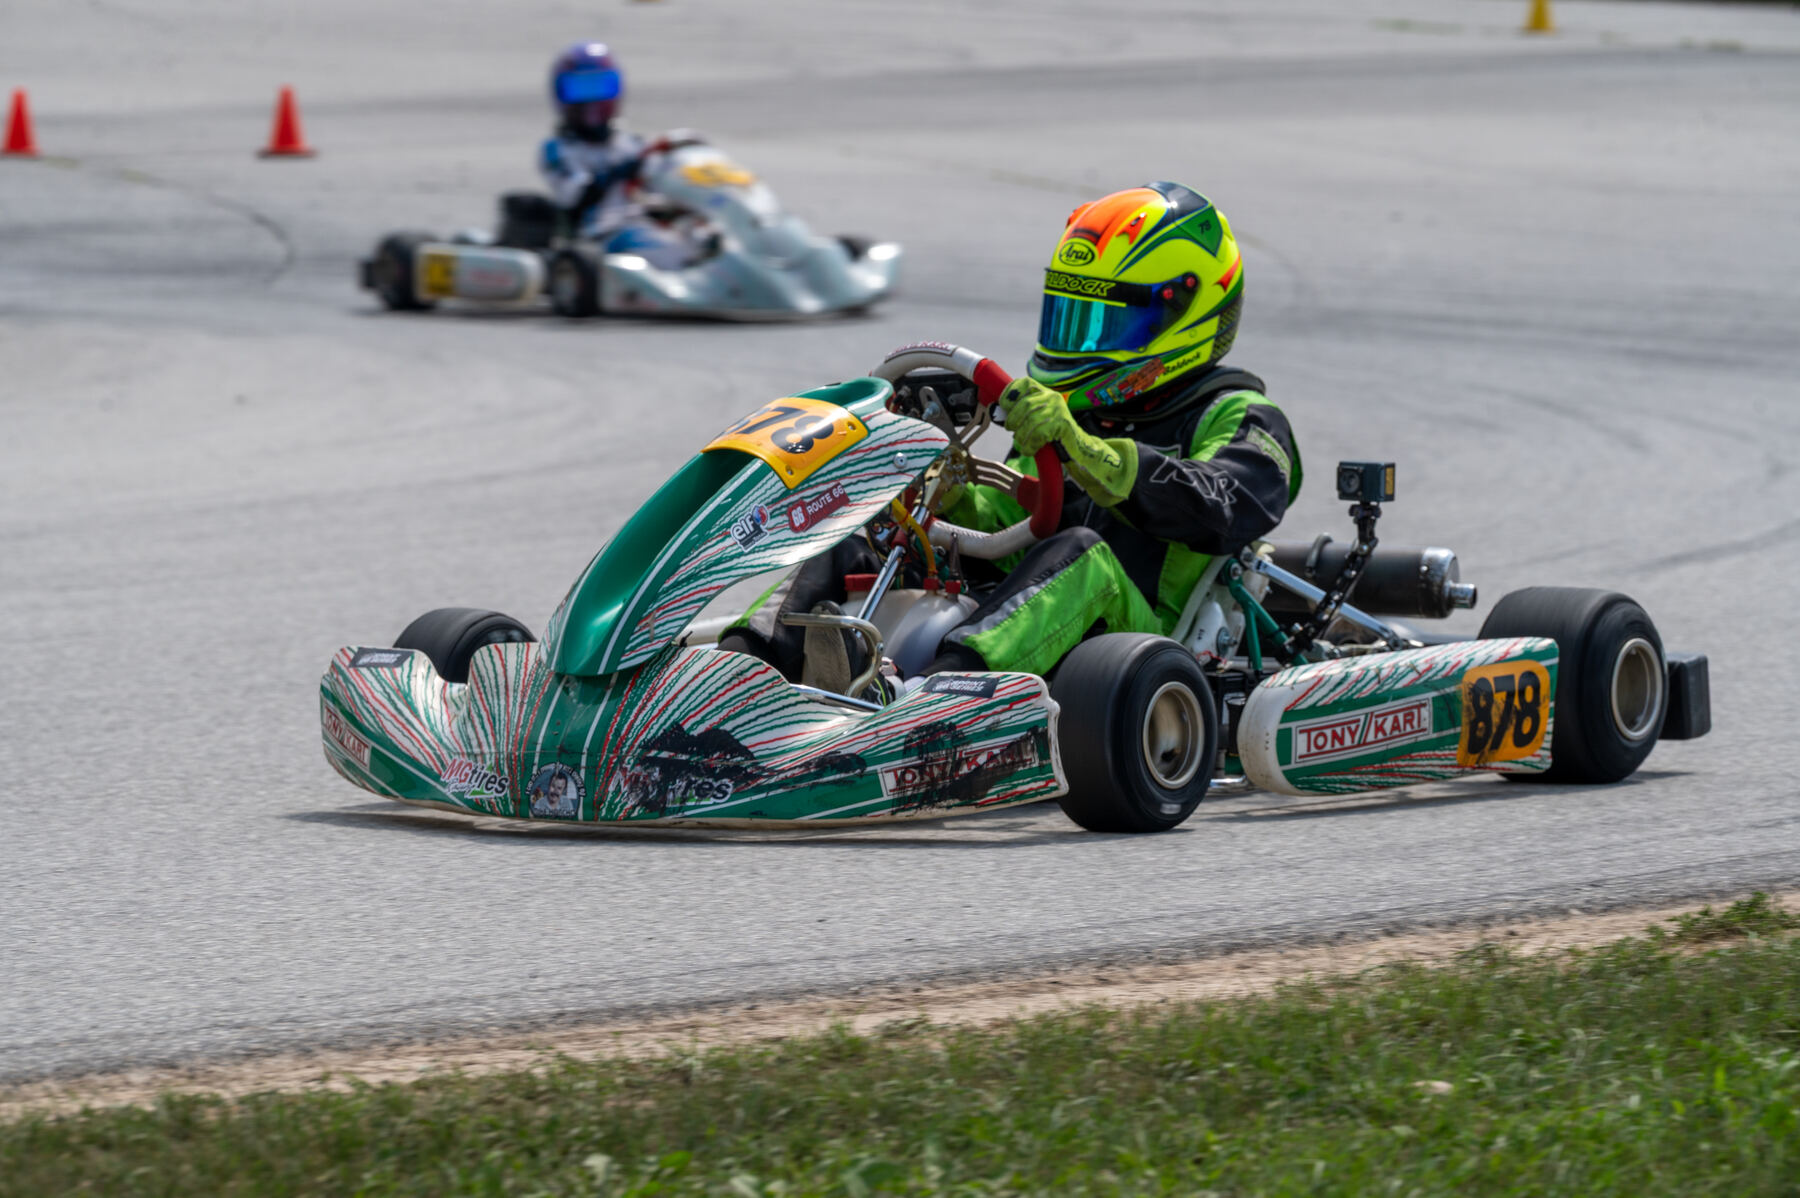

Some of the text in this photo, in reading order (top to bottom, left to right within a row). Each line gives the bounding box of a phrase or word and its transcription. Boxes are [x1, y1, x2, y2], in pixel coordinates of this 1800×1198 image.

[1062, 244, 1090, 261] Arai
[806, 485, 845, 516] ROUTE 66
[732, 514, 755, 541] elf
[791, 506, 806, 527] 66
[1468, 670, 1541, 755] 878
